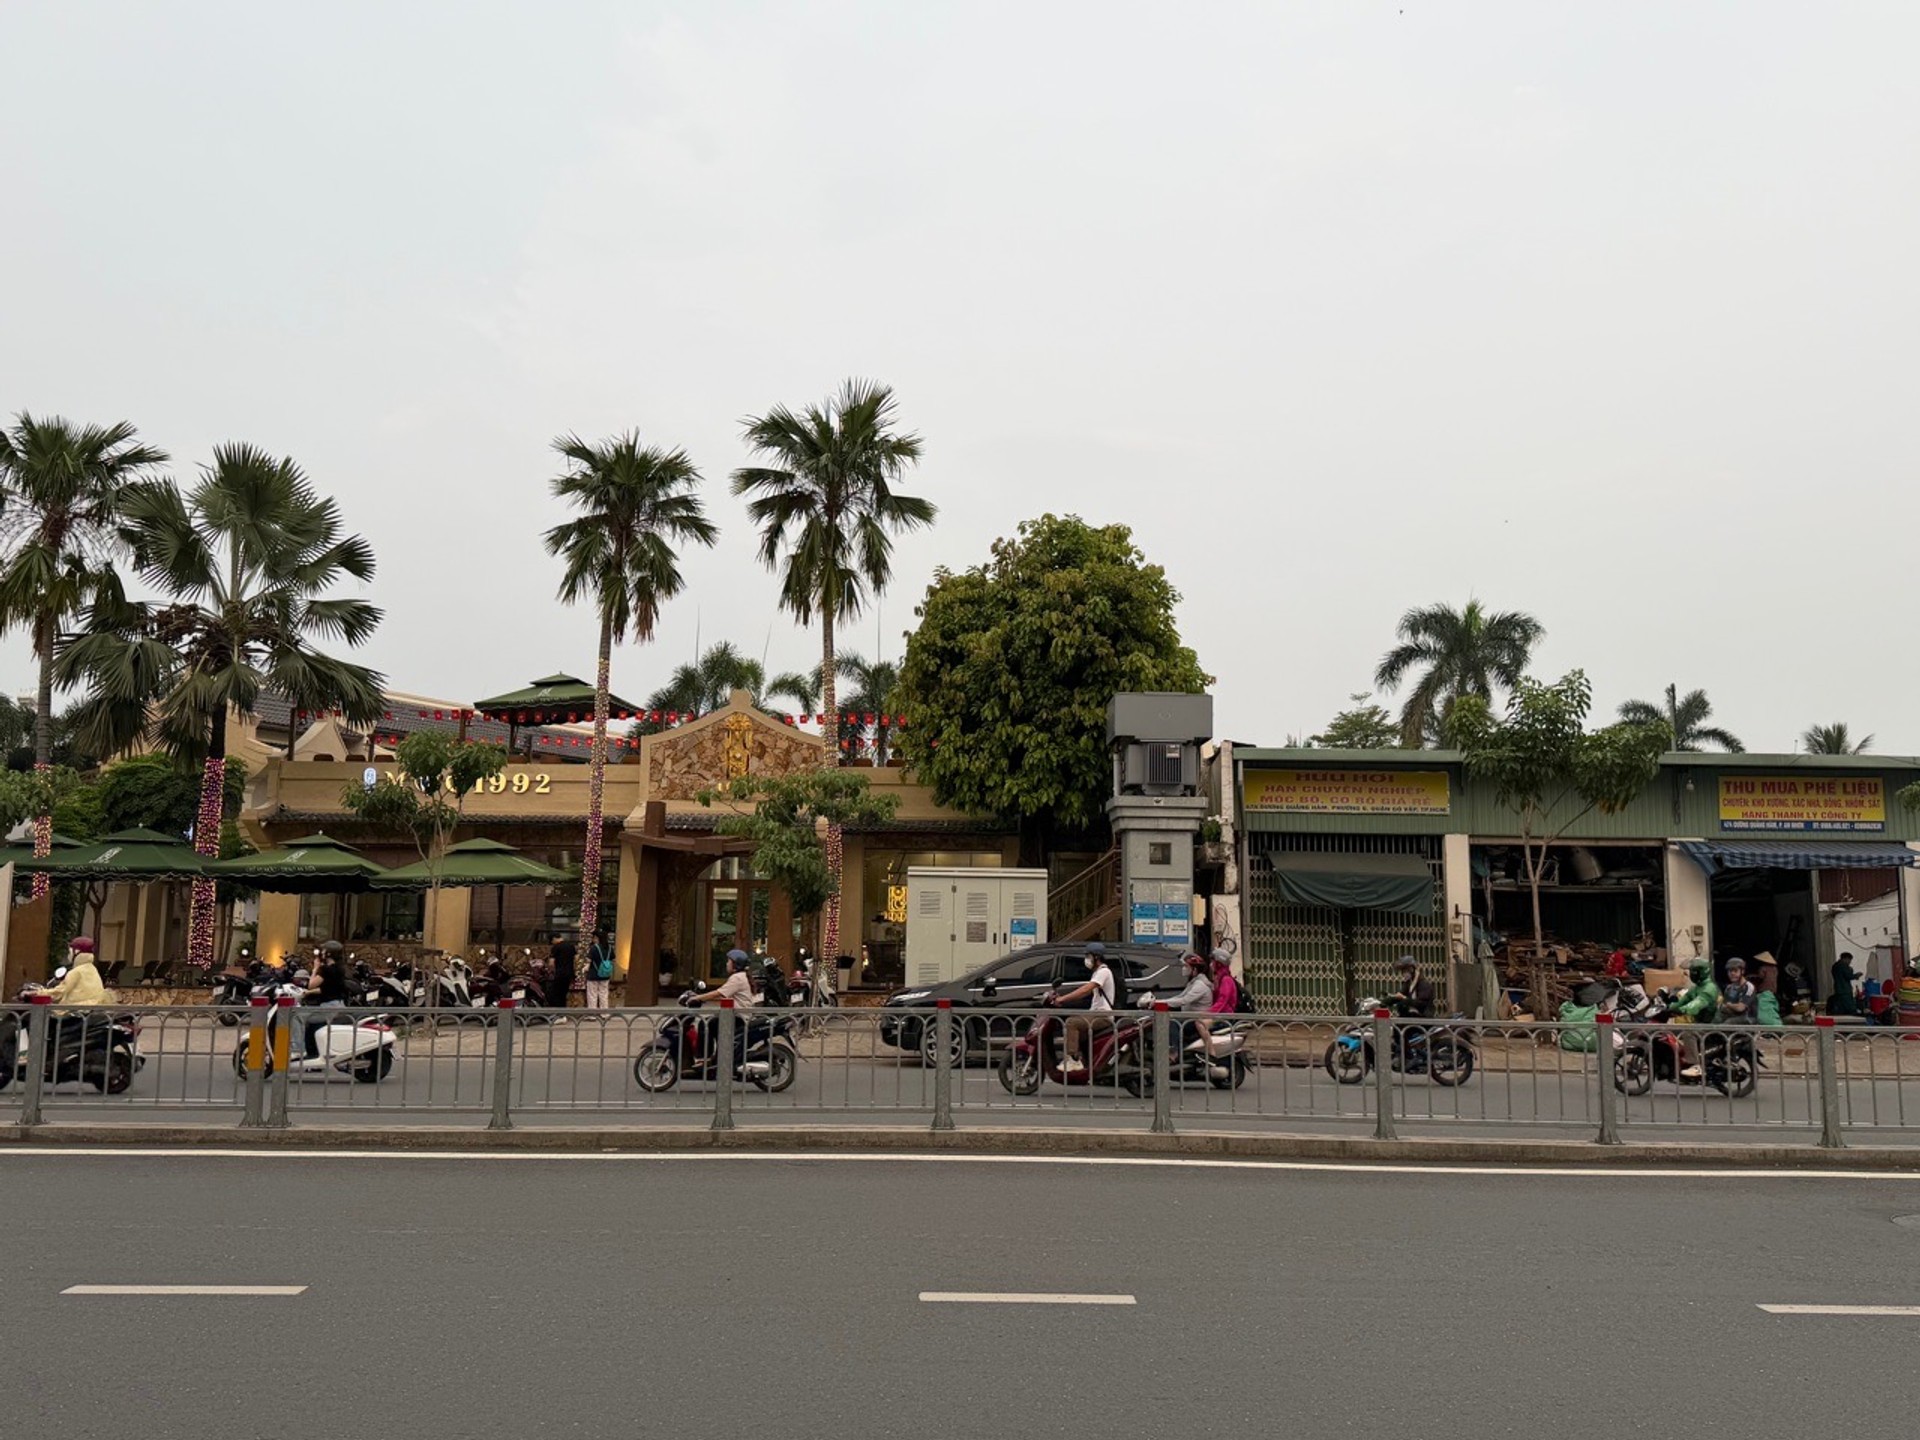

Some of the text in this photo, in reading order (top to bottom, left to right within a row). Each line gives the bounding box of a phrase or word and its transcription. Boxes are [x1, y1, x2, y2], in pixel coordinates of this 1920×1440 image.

[472, 772, 551, 794] 1992
[1724, 778, 1879, 798] THU MUA PHẾ LIỆU
[1772, 810, 1803, 819] THANH
[1821, 810, 1848, 820] CÔNG
[1851, 811, 1862, 820] TY
